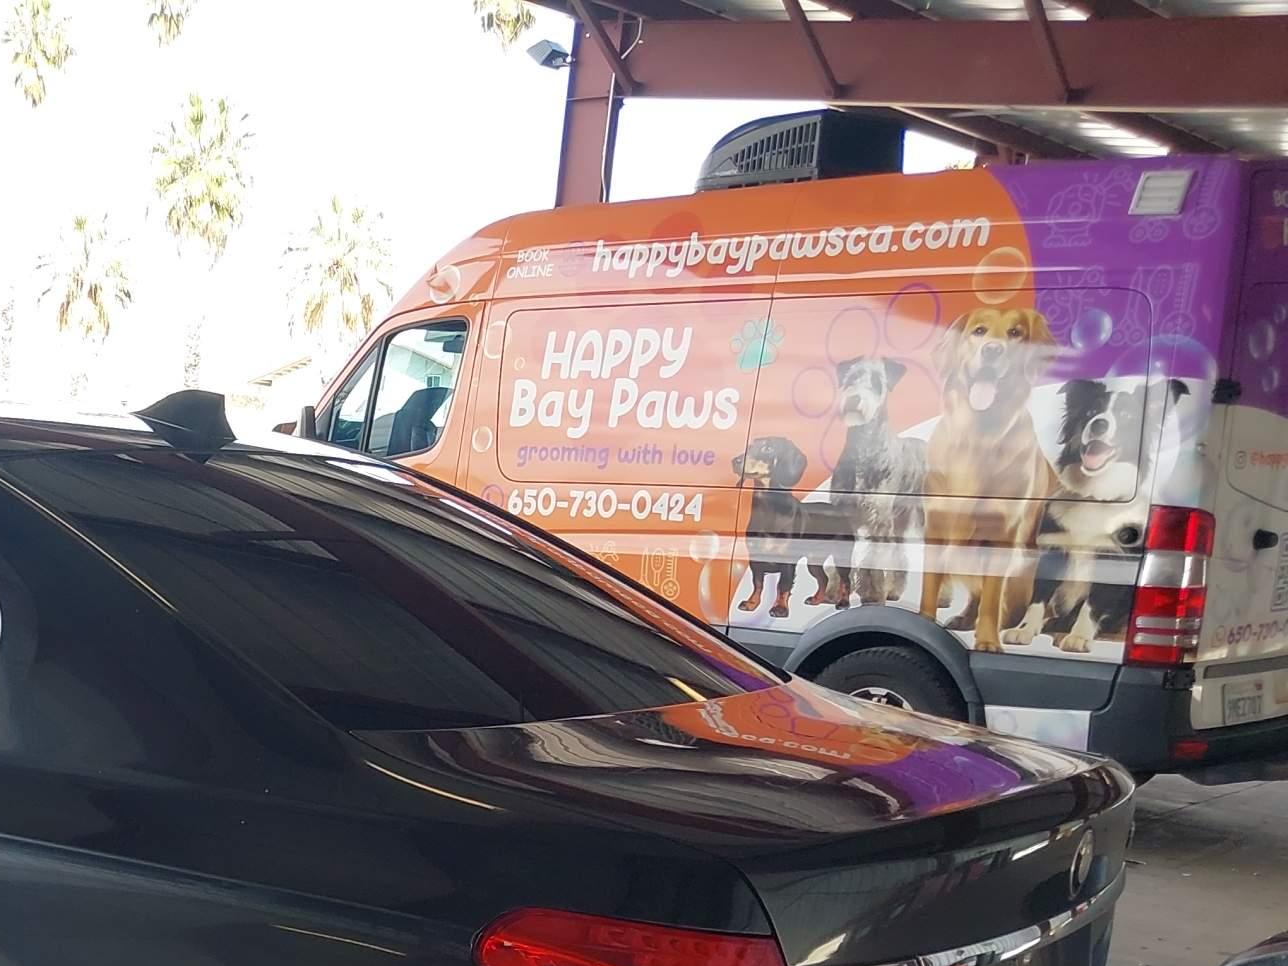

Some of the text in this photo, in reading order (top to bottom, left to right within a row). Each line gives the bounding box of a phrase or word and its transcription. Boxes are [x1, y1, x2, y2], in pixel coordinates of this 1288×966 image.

[516, 249, 550, 263] BOOK
[591, 216, 991, 279] happybaypawsca.com
[506, 263, 554, 279] ONLINE
[540, 326, 693, 380] HAPPY
[509, 377, 740, 439] Bay Paws
[516, 443, 716, 470] grooming with love
[507, 486, 704, 523] 650-730-0424
